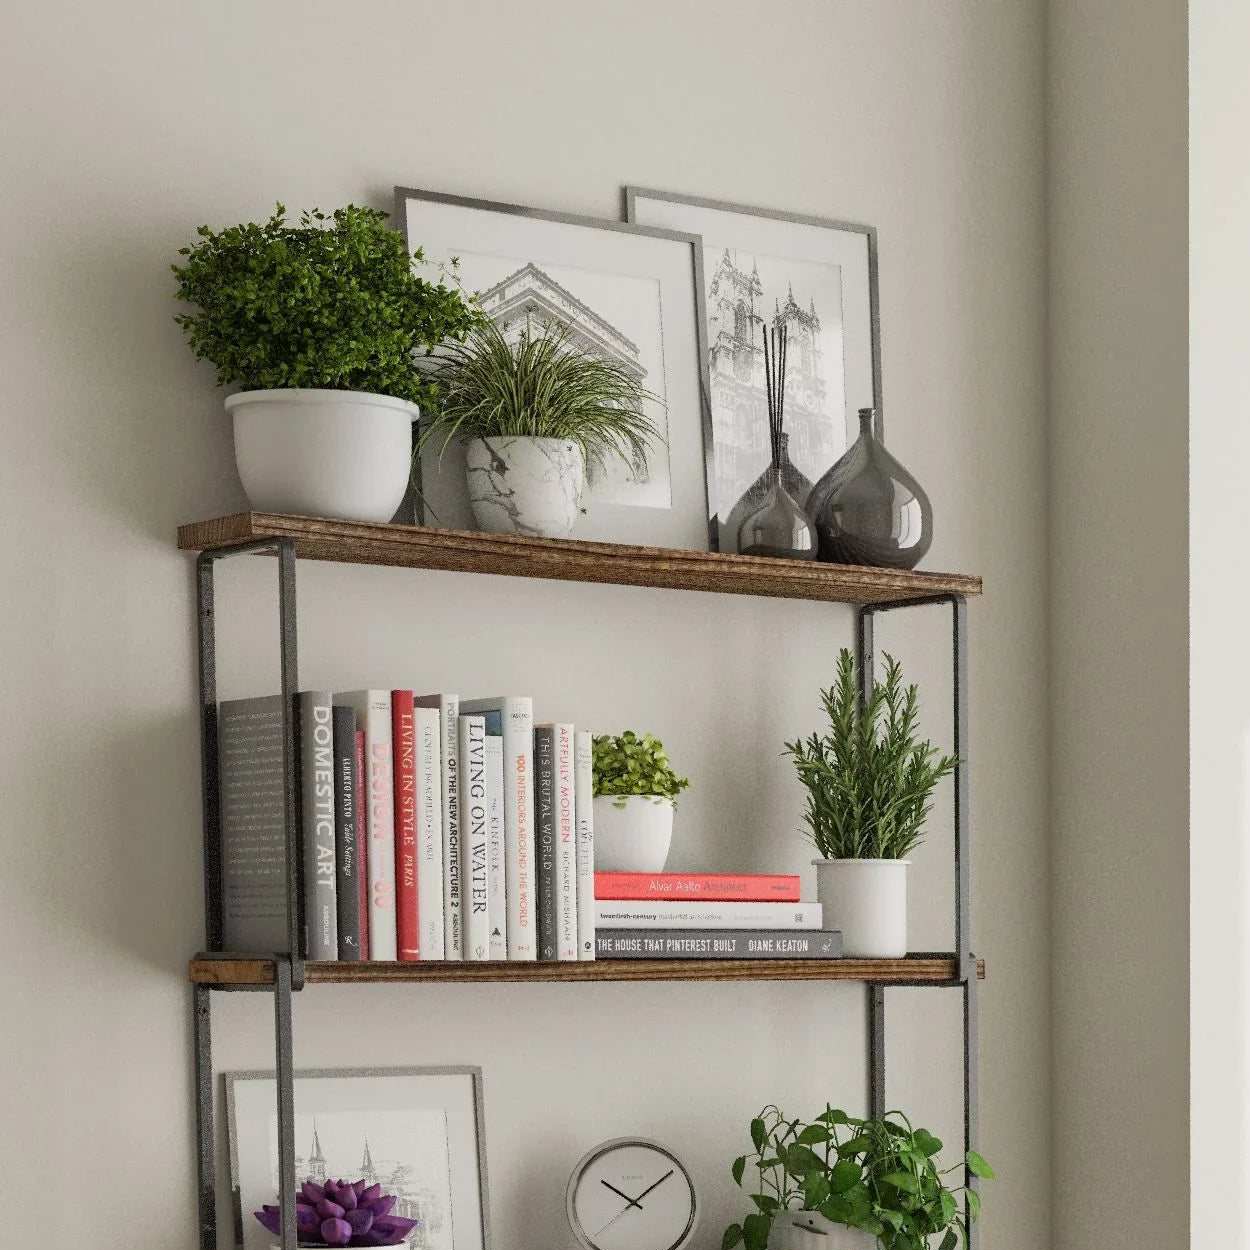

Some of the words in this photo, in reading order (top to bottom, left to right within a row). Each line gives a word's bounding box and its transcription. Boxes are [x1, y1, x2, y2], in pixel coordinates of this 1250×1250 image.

[401, 714, 412, 769] LIVING
[447, 702, 456, 756] PORTRAITS
[448, 758, 458, 773] OF
[469, 723, 484, 799] LIVING
[516, 754, 526, 773] 100
[540, 736, 550, 765] THIS
[559, 727, 569, 781] ARTFULLY
[313, 706, 334, 836] DOMESTIC
[343, 757, 352, 791] ALBERTO
[403, 774, 413, 791] IN
[448, 774, 457, 794] THE
[343, 793, 352, 817] PINTO
[372, 743, 390, 840] DESIGN
[449, 796, 458, 822] NEW
[517, 775, 527, 824] INTERIORS
[541, 771, 552, 819] BRUTAL
[403, 796, 414, 845] STYLE
[471, 806, 485, 836] ON
[561, 786, 570, 843] MODERN
[449, 822, 459, 899] ARCHITECTURE
[518, 827, 528, 869] AROUND
[542, 824, 553, 870] WORLD
[317, 845, 335, 889] ART
[404, 854, 414, 887] PARIS
[472, 842, 487, 914] WATER
[519, 872, 528, 889] THE
[562, 851, 570, 892] RICHARD
[649, 880, 673, 891] Alvar
[676, 881, 700, 891] Aalto
[450, 900, 459, 908] 2
[519, 892, 528, 927] WORLD
[597, 938, 612, 950] THE
[615, 939, 642, 951] HOUSE
[644, 939, 664, 951] THAT
[666, 939, 712, 951] PINTEREST
[714, 939, 737, 951] BUILT
[748, 939, 774, 951] DIANE
[776, 940, 809, 952] KEATON
